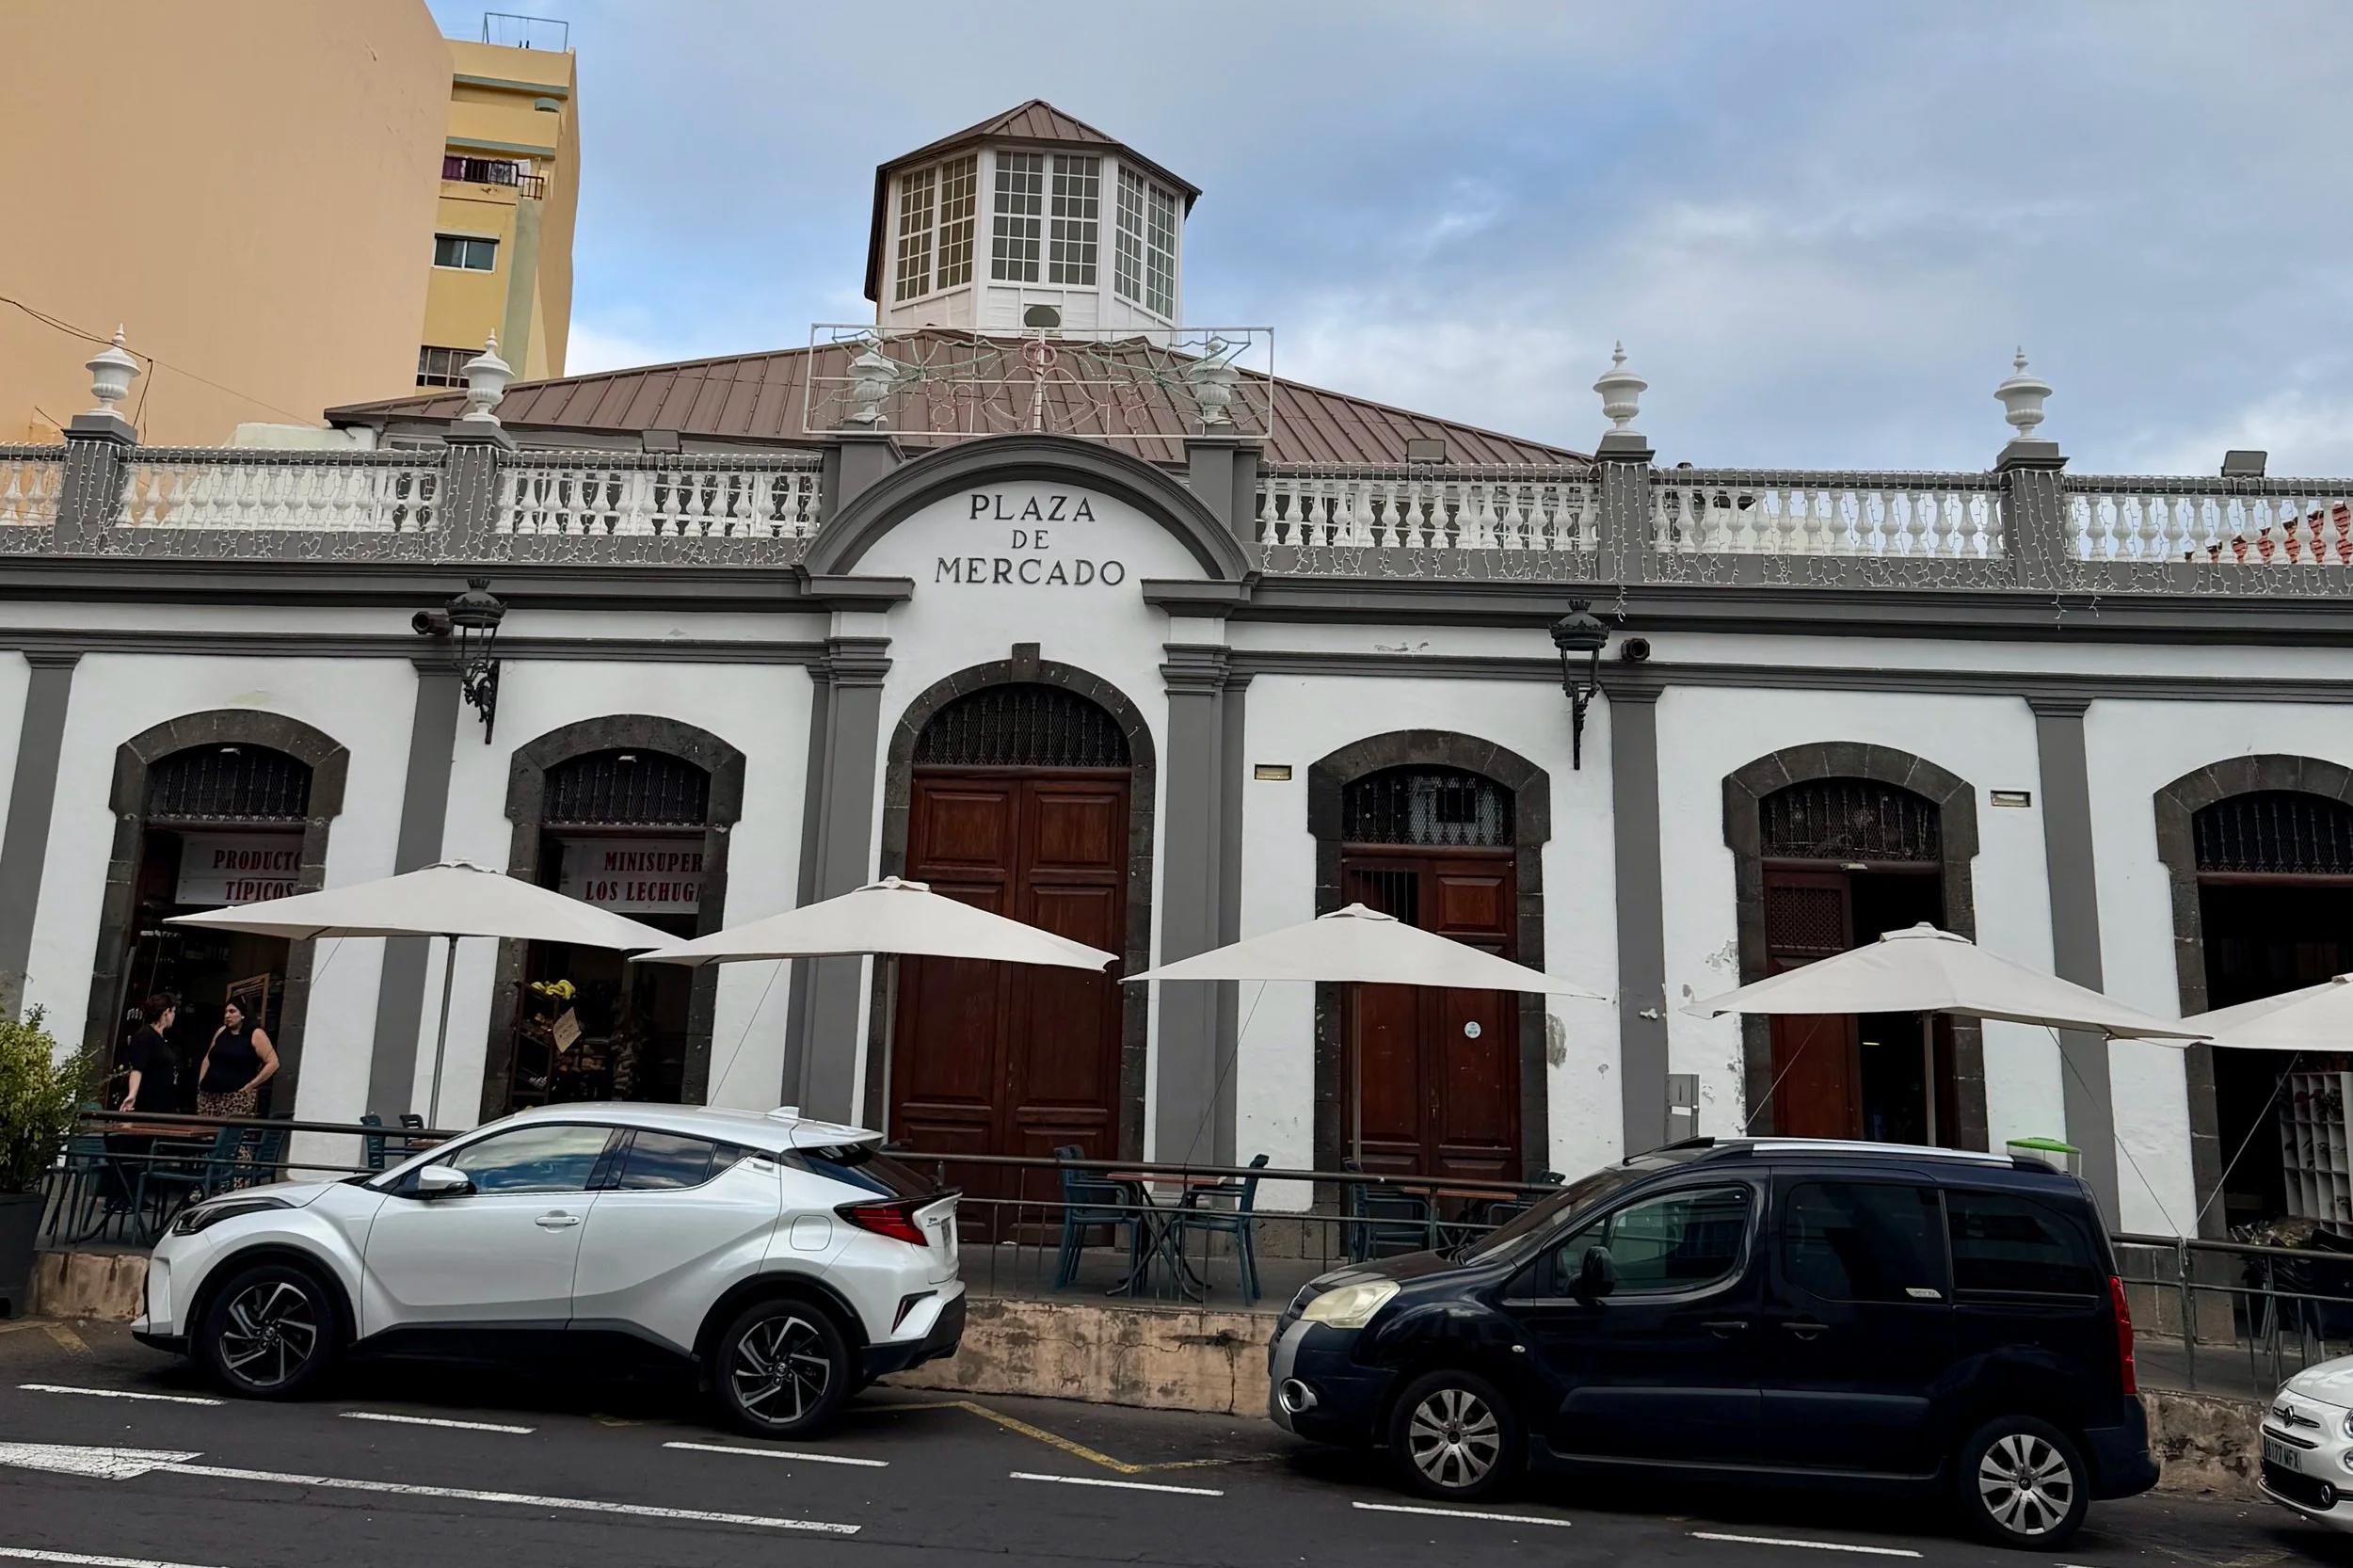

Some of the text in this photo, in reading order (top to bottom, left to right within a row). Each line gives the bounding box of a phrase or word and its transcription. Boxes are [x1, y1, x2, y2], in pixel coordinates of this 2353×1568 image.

[969, 494, 1096, 521] PLAZA
[1011, 529, 1049, 549] DE
[936, 557, 1125, 585] MERCADO
[604, 852, 703, 872] MINISUPER
[584, 881, 618, 901] LOS
